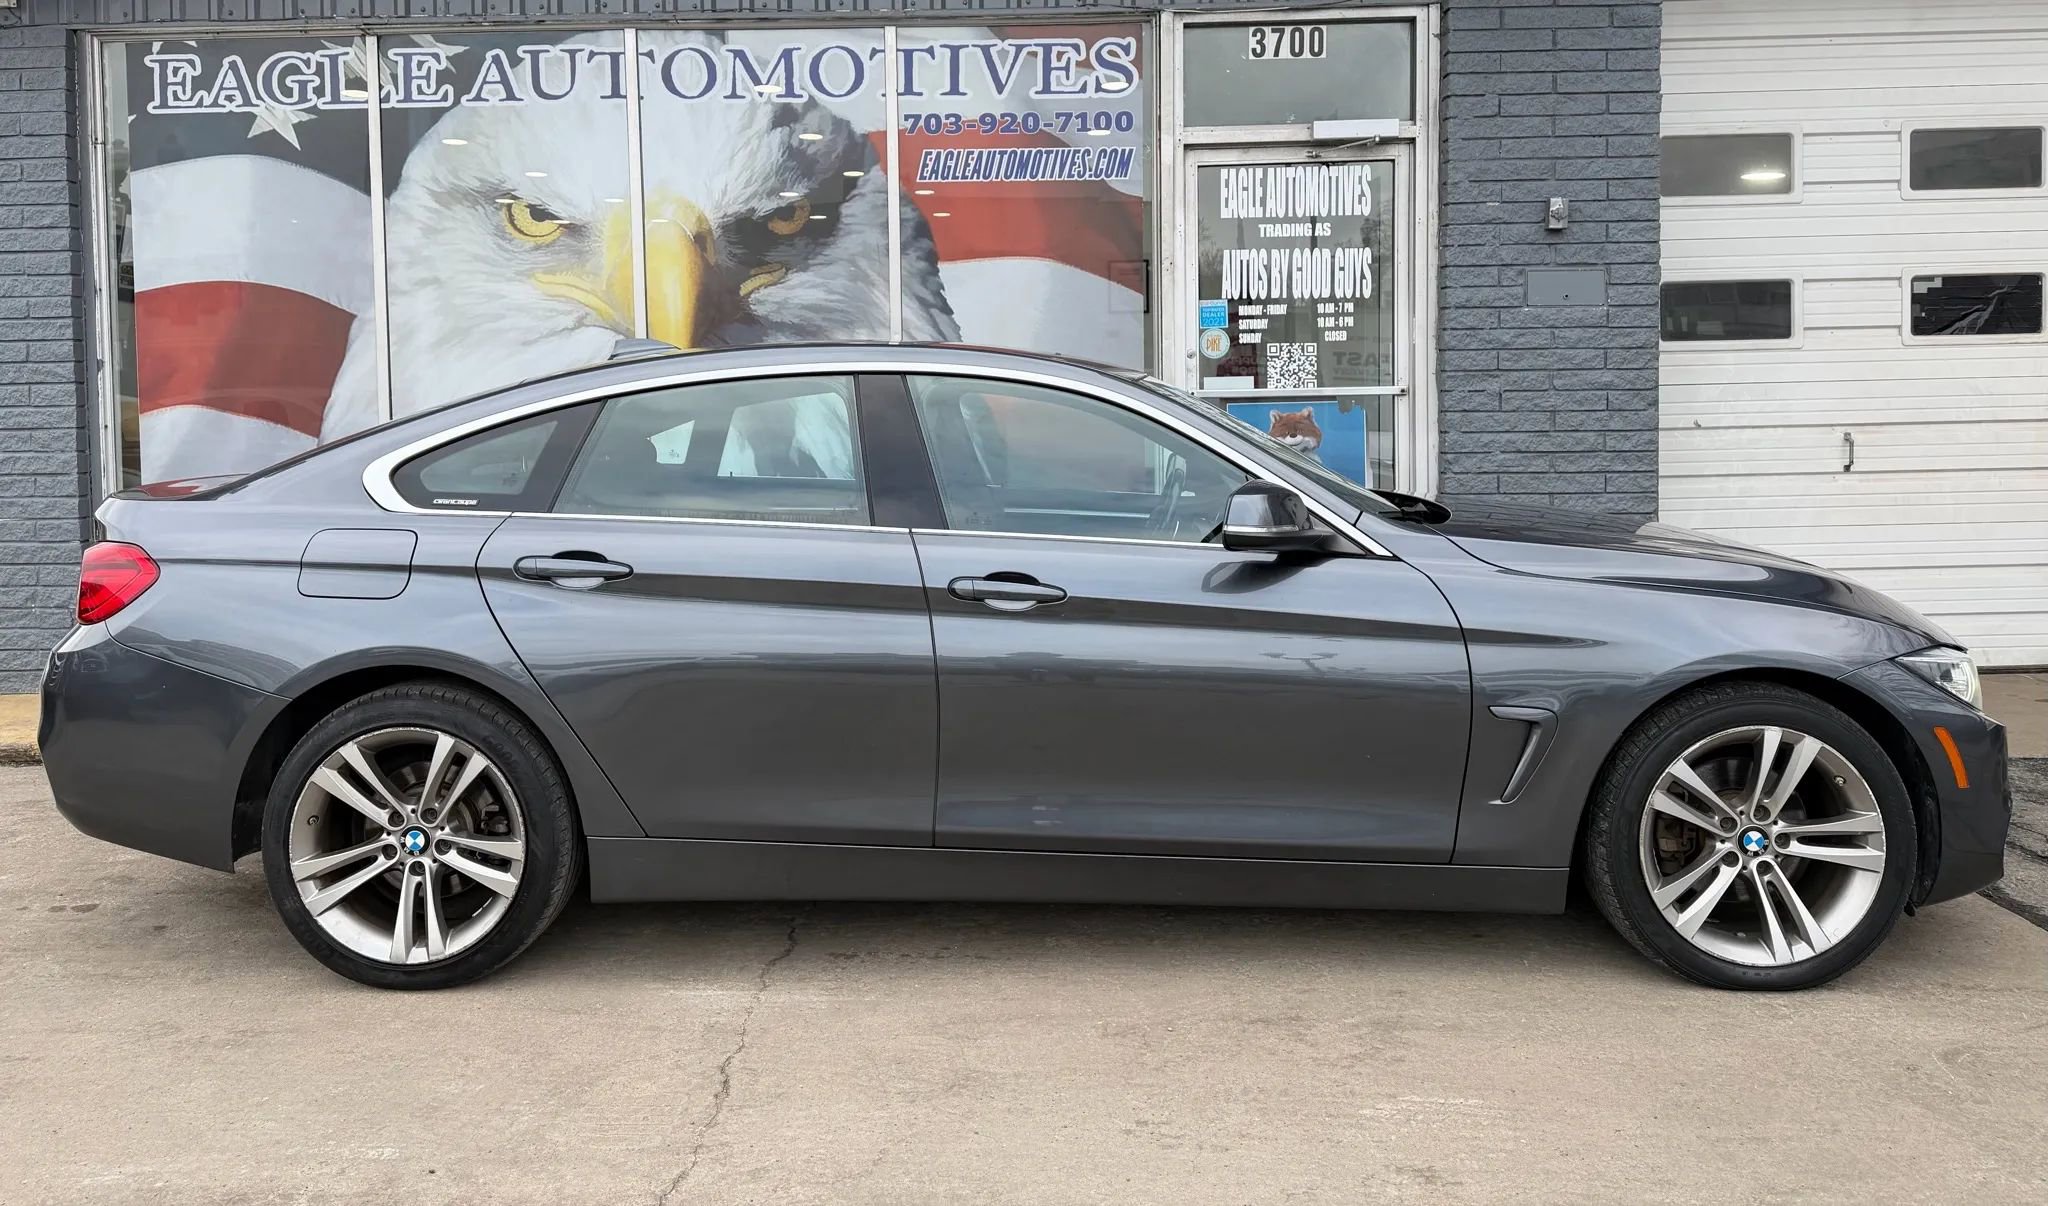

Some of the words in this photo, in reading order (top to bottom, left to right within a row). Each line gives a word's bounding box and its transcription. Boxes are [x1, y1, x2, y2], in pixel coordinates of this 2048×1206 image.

[1251, 26, 1324, 58] 3700
[144, 46, 454, 114] EAGLE
[461, 37, 1137, 107] AUTOMOTIVES
[903, 110, 1135, 136] 703-920-7100
[917, 146, 1136, 182] EAGLEAUTOMOTIVES.COM
[1220, 168, 1263, 219] EAGLE
[1265, 165, 1372, 218] AUTOMOTIVES
[1258, 223, 1313, 237] TRADING
[1314, 222, 1331, 236] AS
[1221, 249, 1268, 300] AUTOS
[1270, 248, 1290, 299] BY
[1292, 248, 1331, 299] GOOD
[1334, 247, 1372, 299] GUYS
[1239, 305, 1263, 316] MONDAY
[1267, 304, 1287, 315] FRIDAY
[1317, 303, 1324, 314] 10
[1325, 302, 1335, 314] AM
[1339, 302, 1343, 313] 7
[1344, 302, 1354, 313] PM
[1202, 317, 1225, 327] 2021
[1239, 318, 1268, 330] SATURDAY
[1317, 317, 1324, 328] 10
[1325, 316, 1335, 327] AM
[1339, 316, 1344, 327] 6
[1344, 316, 1354, 327] PM
[1239, 332, 1262, 344] SUNDAY
[1324, 330, 1347, 341] CLOSED
